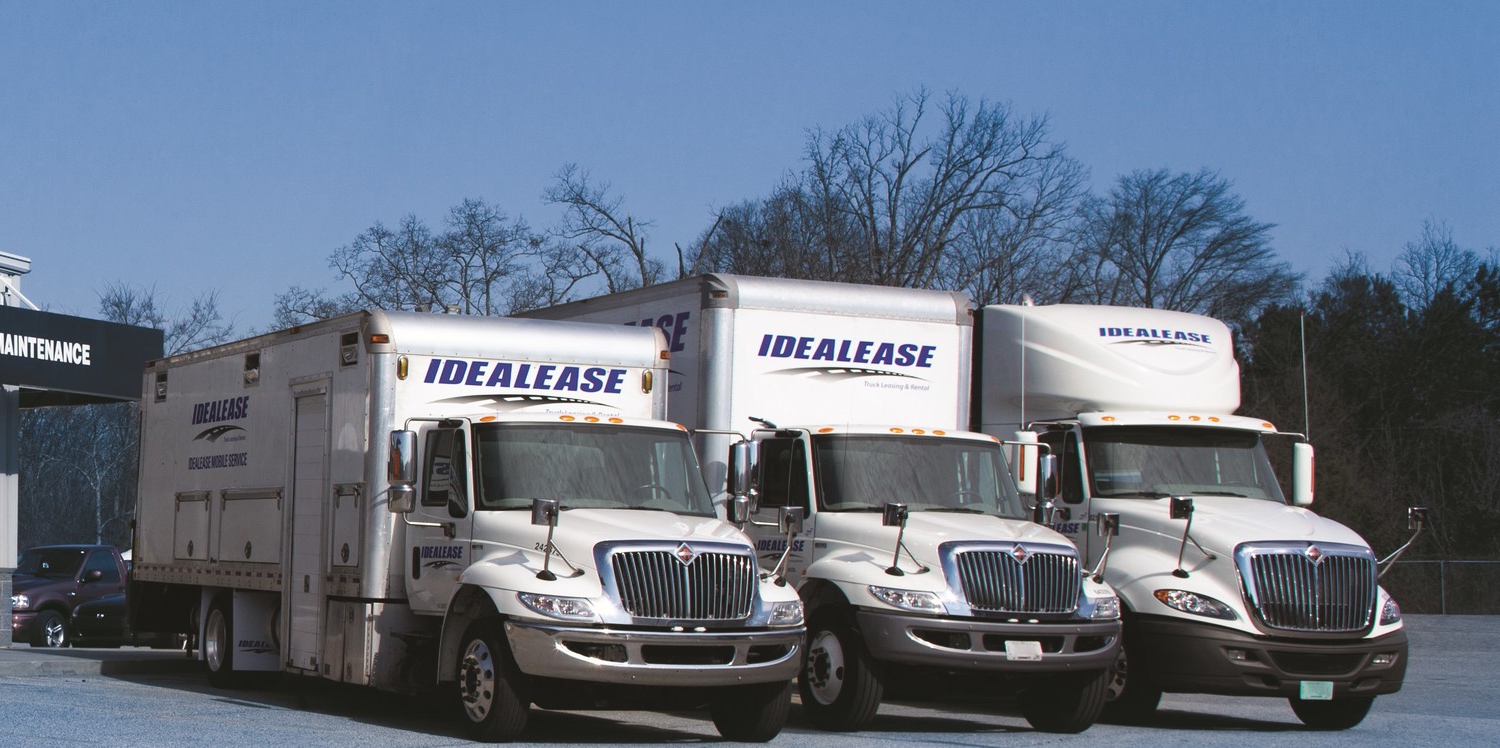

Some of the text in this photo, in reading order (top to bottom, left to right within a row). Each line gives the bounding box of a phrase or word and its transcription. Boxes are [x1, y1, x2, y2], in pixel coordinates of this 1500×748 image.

[1099, 327, 1212, 344] IDEALEASE
[757, 334, 937, 368] IDEALEASE
[423, 358, 627, 394] IDEALEASE
[880, 382, 903, 391] Leasing
[192, 396, 249, 425] IDEALEASE
[188, 452, 247, 470] IDEALEASE MOBILE SERVICE
[421, 546, 463, 558] IDEALEASE
